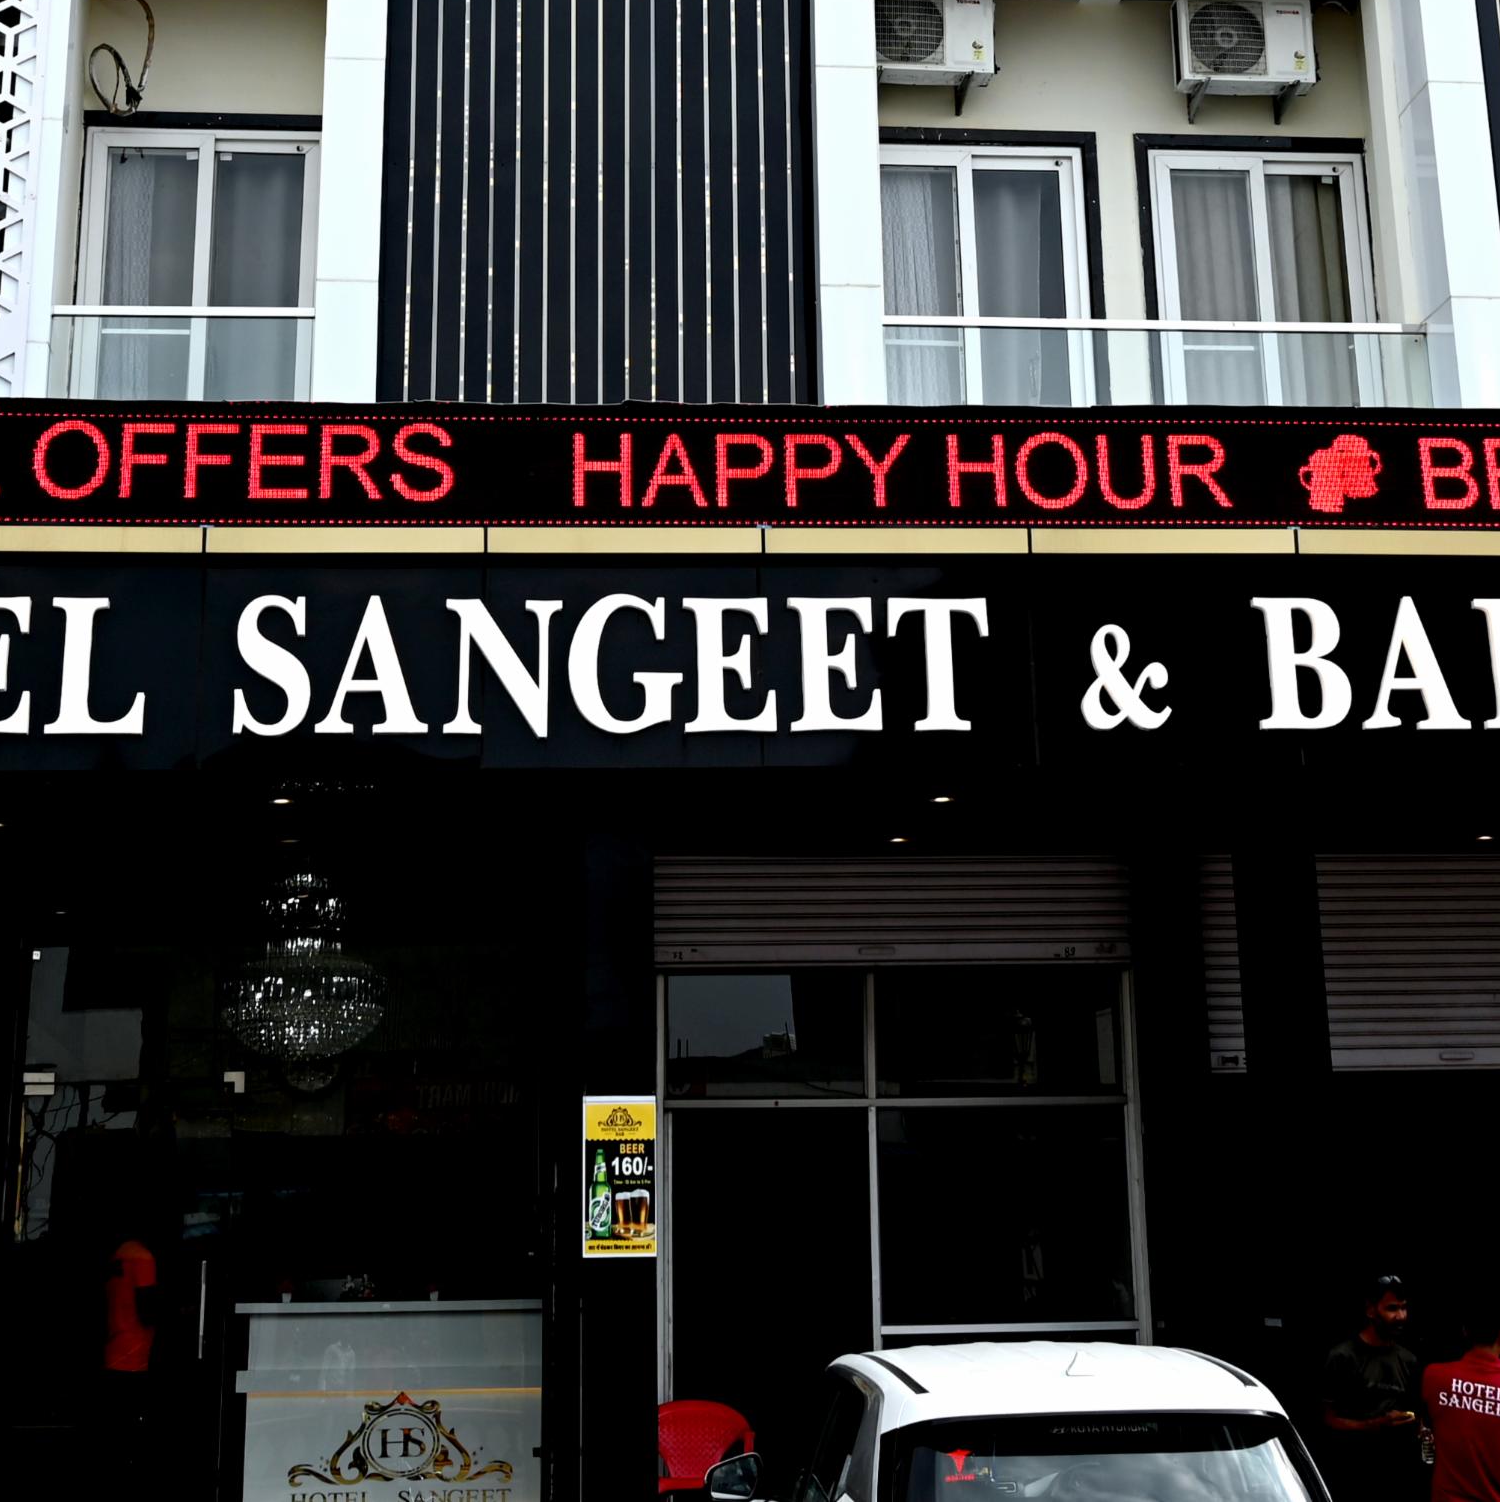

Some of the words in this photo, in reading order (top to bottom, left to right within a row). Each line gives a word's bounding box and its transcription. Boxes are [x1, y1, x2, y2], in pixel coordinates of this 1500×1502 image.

[33, 418, 454, 502] OFFERS
[573, 433, 911, 507] HAPPY
[946, 432, 1233, 510] HOUR
[233, 594, 988, 738] SANGEET
[1081, 624, 1173, 730] &
[611, 1156, 654, 1176] 160/-
[619, 1143, 645, 1155] BEER
